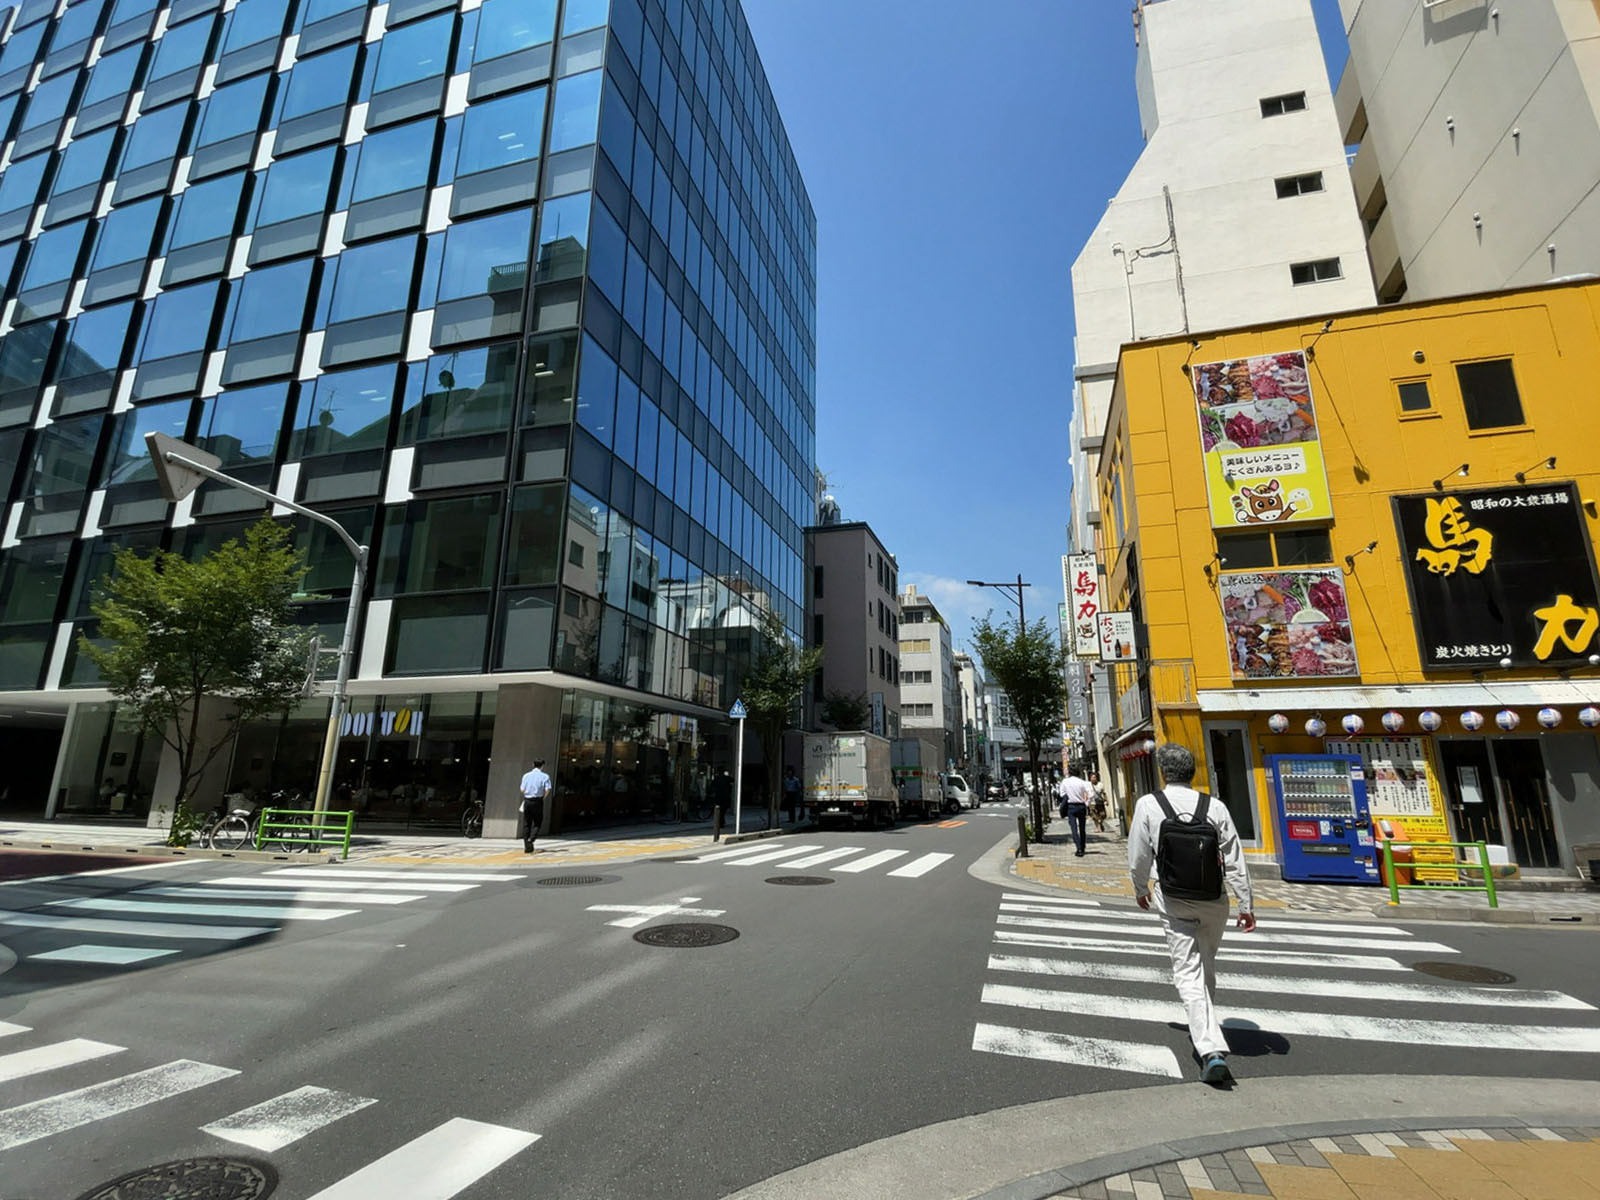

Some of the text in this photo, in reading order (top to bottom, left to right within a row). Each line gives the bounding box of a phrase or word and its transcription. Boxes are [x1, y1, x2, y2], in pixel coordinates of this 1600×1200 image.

[1226, 453, 1300, 466] 美味しいメニュー
[1470, 492, 1570, 511] 昭和の大衆酒場
[1074, 571, 1097, 620] 馬力
[1100, 616, 1115, 652] ホッピー
[1435, 643, 1512, 659] 炭火焼きとり
